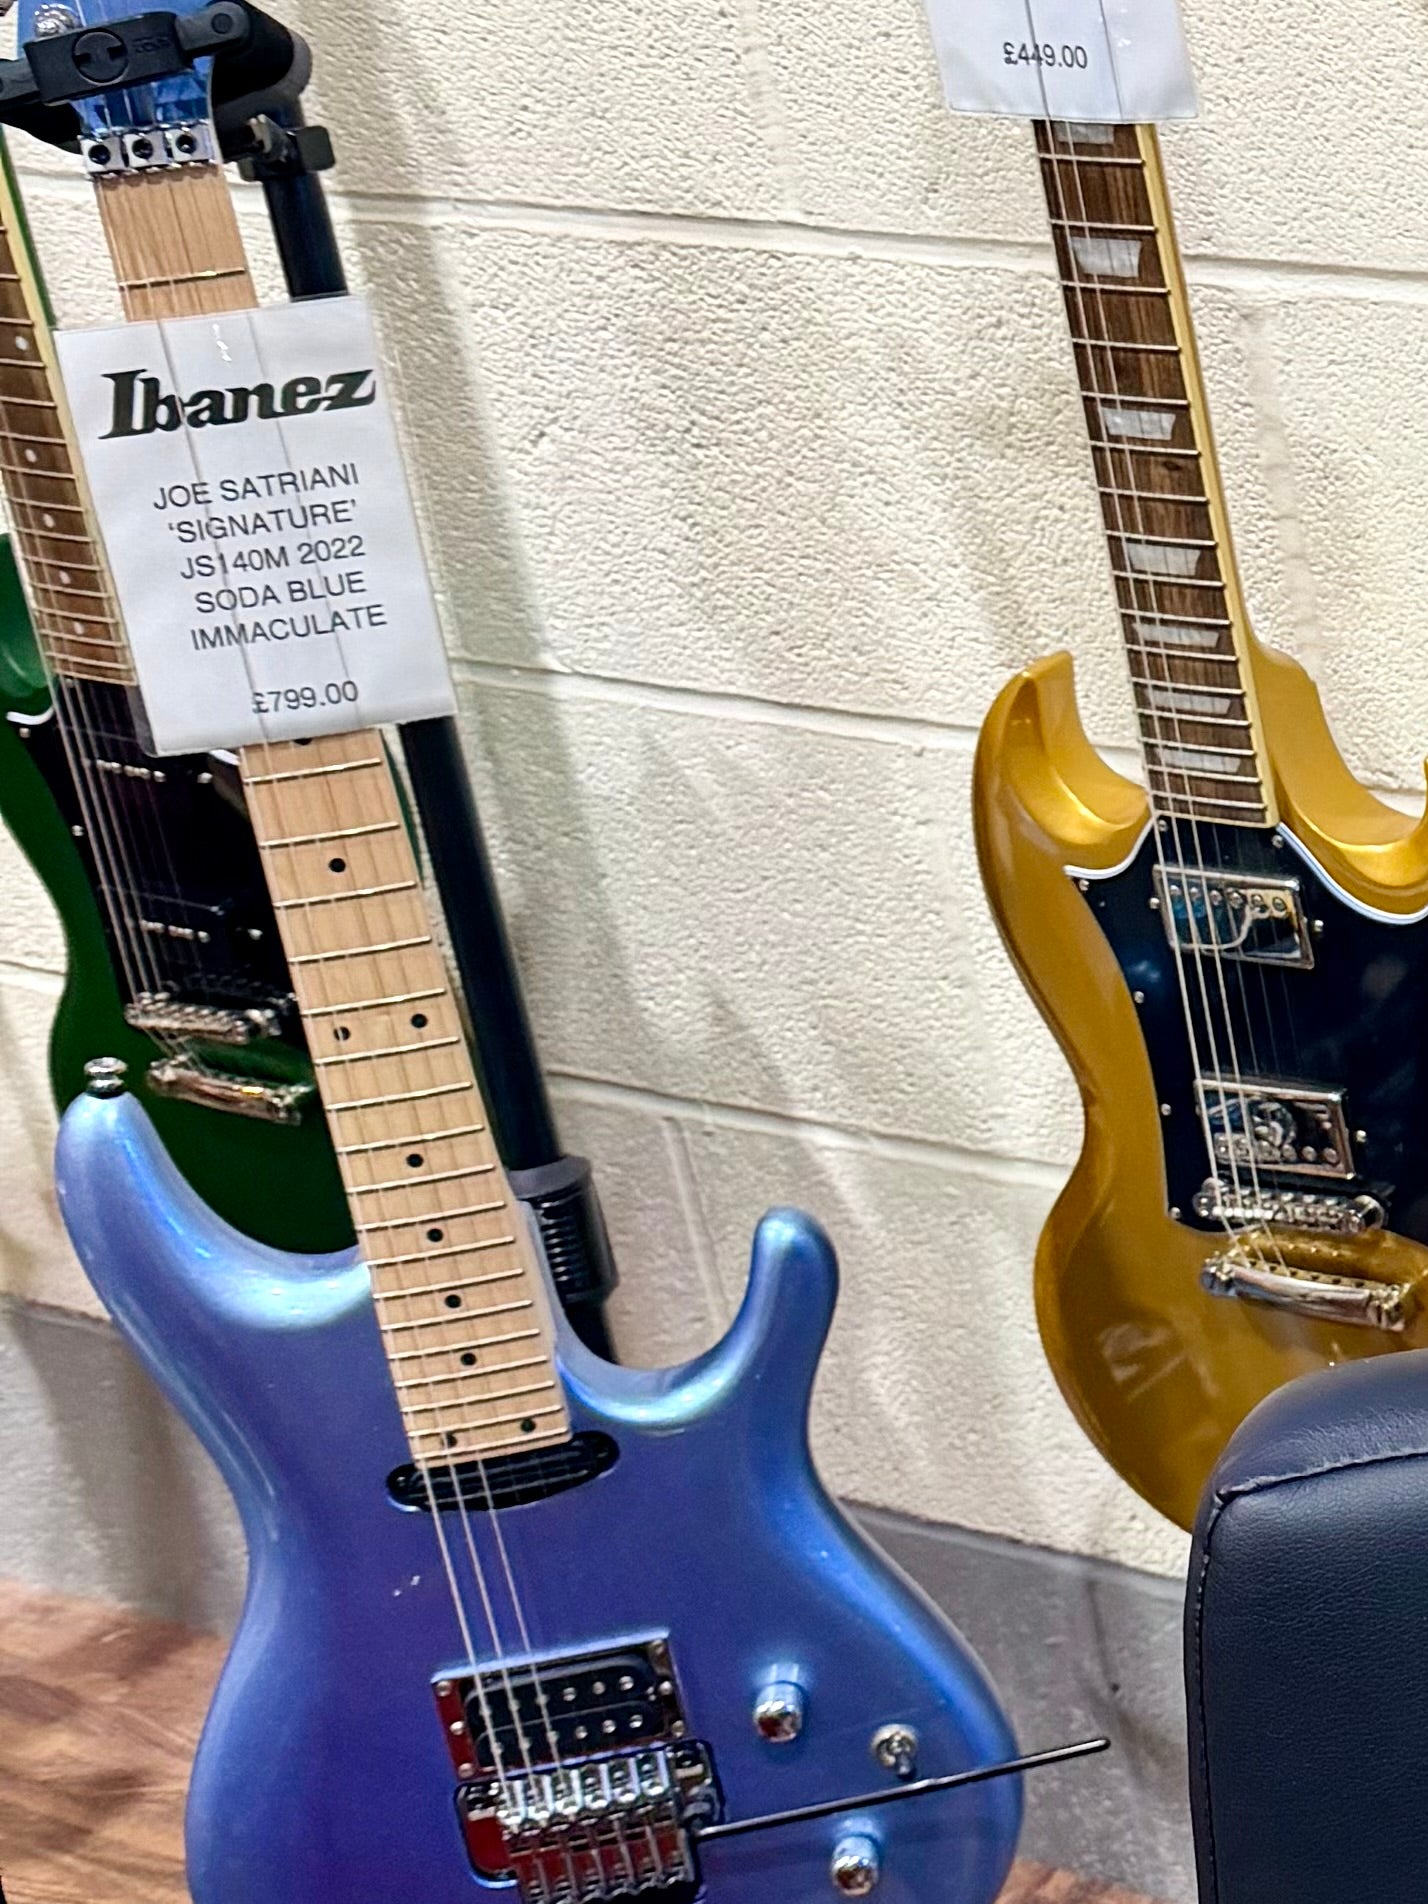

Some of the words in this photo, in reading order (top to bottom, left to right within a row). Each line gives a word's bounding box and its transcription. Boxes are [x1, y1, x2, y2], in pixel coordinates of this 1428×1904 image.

[1003, 42, 1088, 68] £449.00
[98, 368, 377, 440] Ibanez
[153, 482, 212, 510] JOE
[220, 462, 360, 503] SATRIANI
[180, 545, 290, 580] JS140M
[298, 534, 365, 565] 2022
[195, 583, 280, 613] SODA
[289, 570, 367, 602] BLUE
[190, 604, 388, 651] IMMACULATE
[252, 680, 359, 714] £799.00
